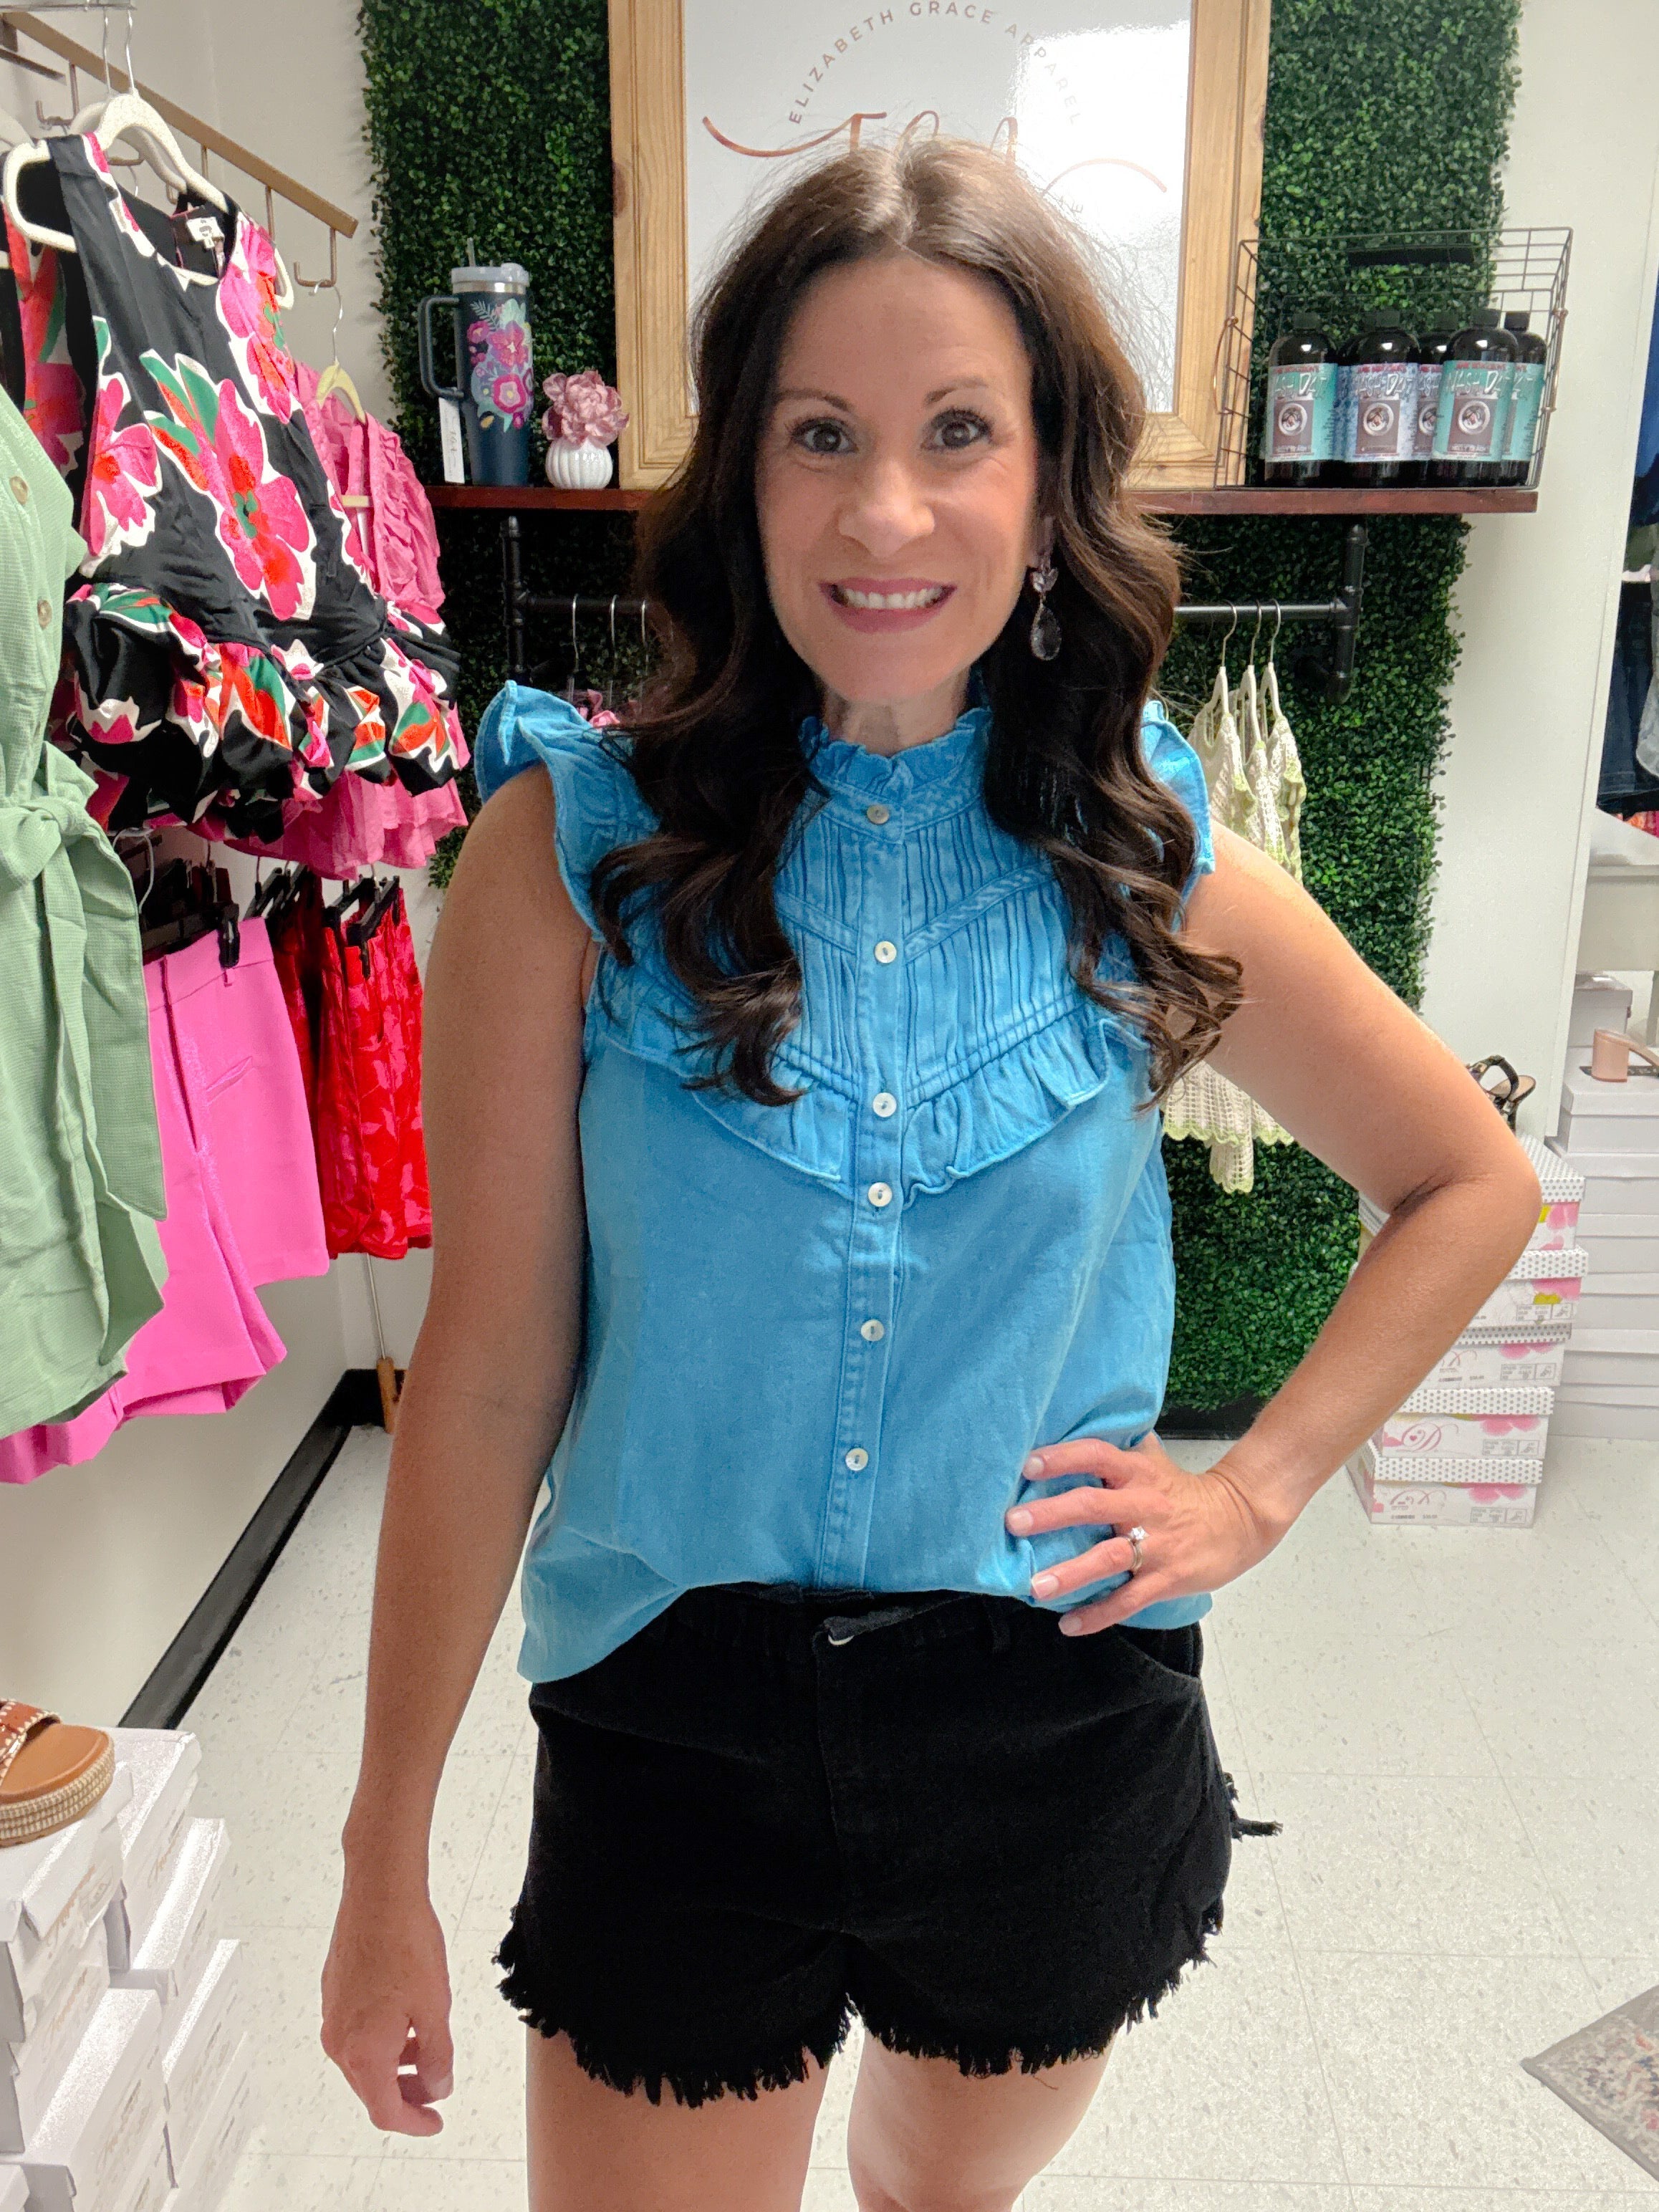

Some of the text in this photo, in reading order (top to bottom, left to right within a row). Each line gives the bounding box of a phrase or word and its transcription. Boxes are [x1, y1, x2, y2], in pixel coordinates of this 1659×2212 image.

[789, 1, 1081, 125] ELIZABETH GRACE APPAREL
